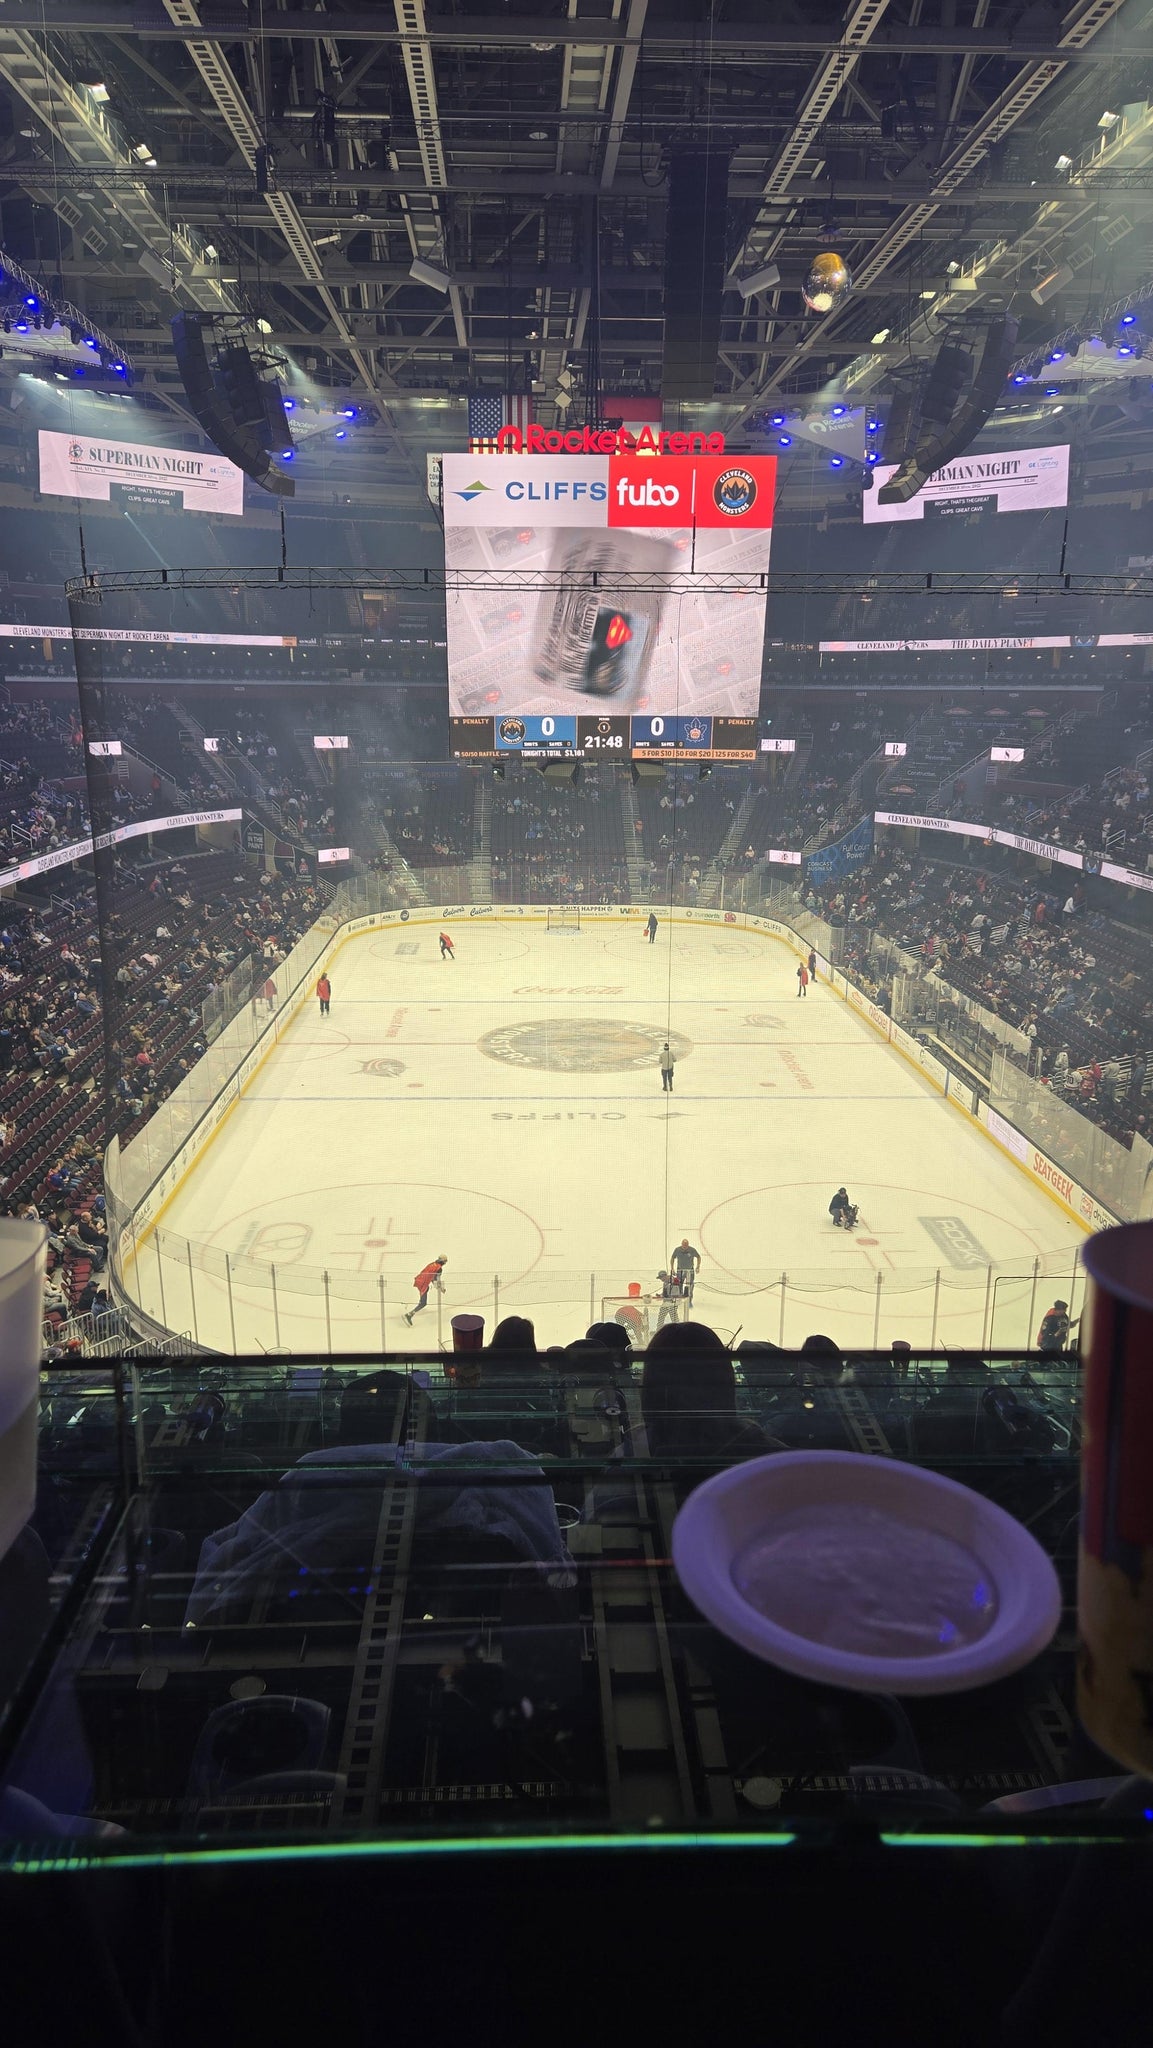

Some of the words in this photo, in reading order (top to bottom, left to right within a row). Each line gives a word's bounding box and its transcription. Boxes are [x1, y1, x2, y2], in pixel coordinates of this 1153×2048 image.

[527, 424, 630, 455] Rocket
[635, 425, 725, 455] Arena
[89, 447, 160, 470] SUPERMAN
[162, 456, 204, 475] NIGHT
[719, 470, 752, 483] CLEVELAND
[929, 464, 975, 482] ERMAN
[976, 460, 1020, 477] NIGHT
[505, 481, 607, 501] CLIFFS
[616, 478, 679, 507] fubo
[718, 502, 749, 514] MONSTERS
[13, 627, 41, 635] CLEVELAND
[42, 627, 67, 636] MONSTERS
[108, 631, 124, 639] NIGHT
[125, 632, 132, 640] AT
[132, 632, 152, 640] ROCKET
[153, 633, 170, 641] ARENA
[857, 641, 894, 649] CLEVELAND
[952, 641, 971, 649] THE
[972, 640, 1000, 648] DAILY
[1000, 638, 1034, 648] PLANET
[541, 717, 555, 736] 0
[650, 716, 664, 736] 0
[585, 736, 623, 748] 21:48
[775, 741, 782, 750] E
[892, 744, 899, 754] R
[1005, 750, 1011, 759] S
[166, 814, 194, 826] CLEVELAND
[195, 813, 224, 823] MONSTERS
[888, 815, 921, 825] CLEVELAND
[922, 819, 950, 829] MONSTERS
[1014, 836, 1024, 847] THE
[1039, 843, 1060, 860] PLANET
[846, 852, 865, 860] Power
[763, 921, 781, 934] CLIFFS
[491, 1112, 626, 1121] CLIFFS
[1032, 1152, 1074, 1204] SEATGEEK
